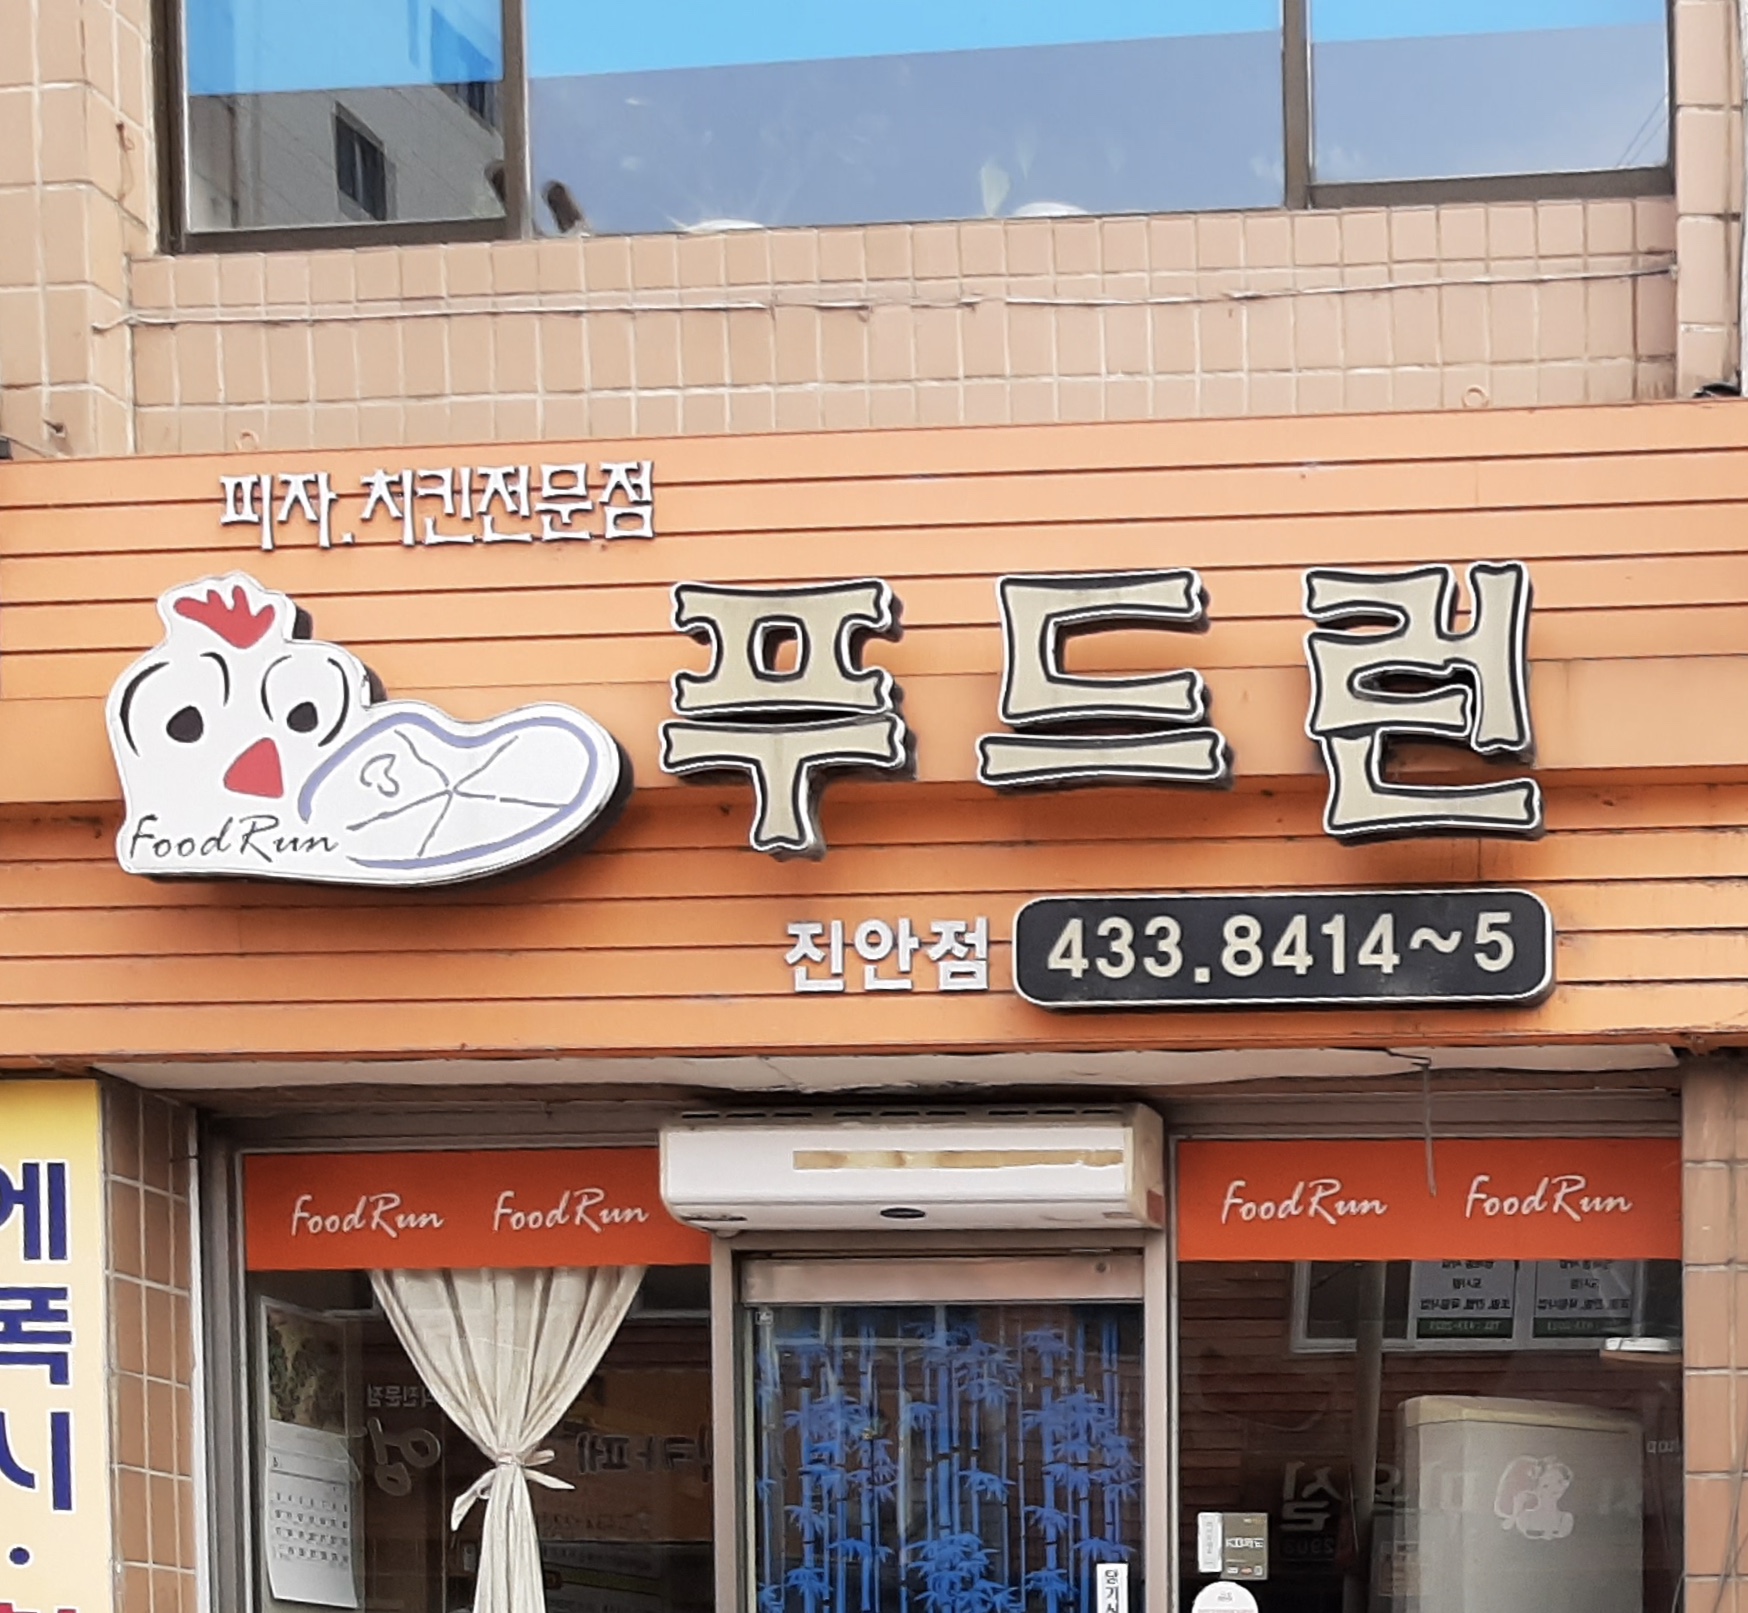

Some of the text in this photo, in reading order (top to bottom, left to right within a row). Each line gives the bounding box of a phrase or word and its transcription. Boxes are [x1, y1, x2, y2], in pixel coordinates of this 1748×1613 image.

[658, 560, 1542, 855] 푸드런
[783, 916, 990, 993] 진안점
[1046, 912, 1517, 985] 433.8414~5
